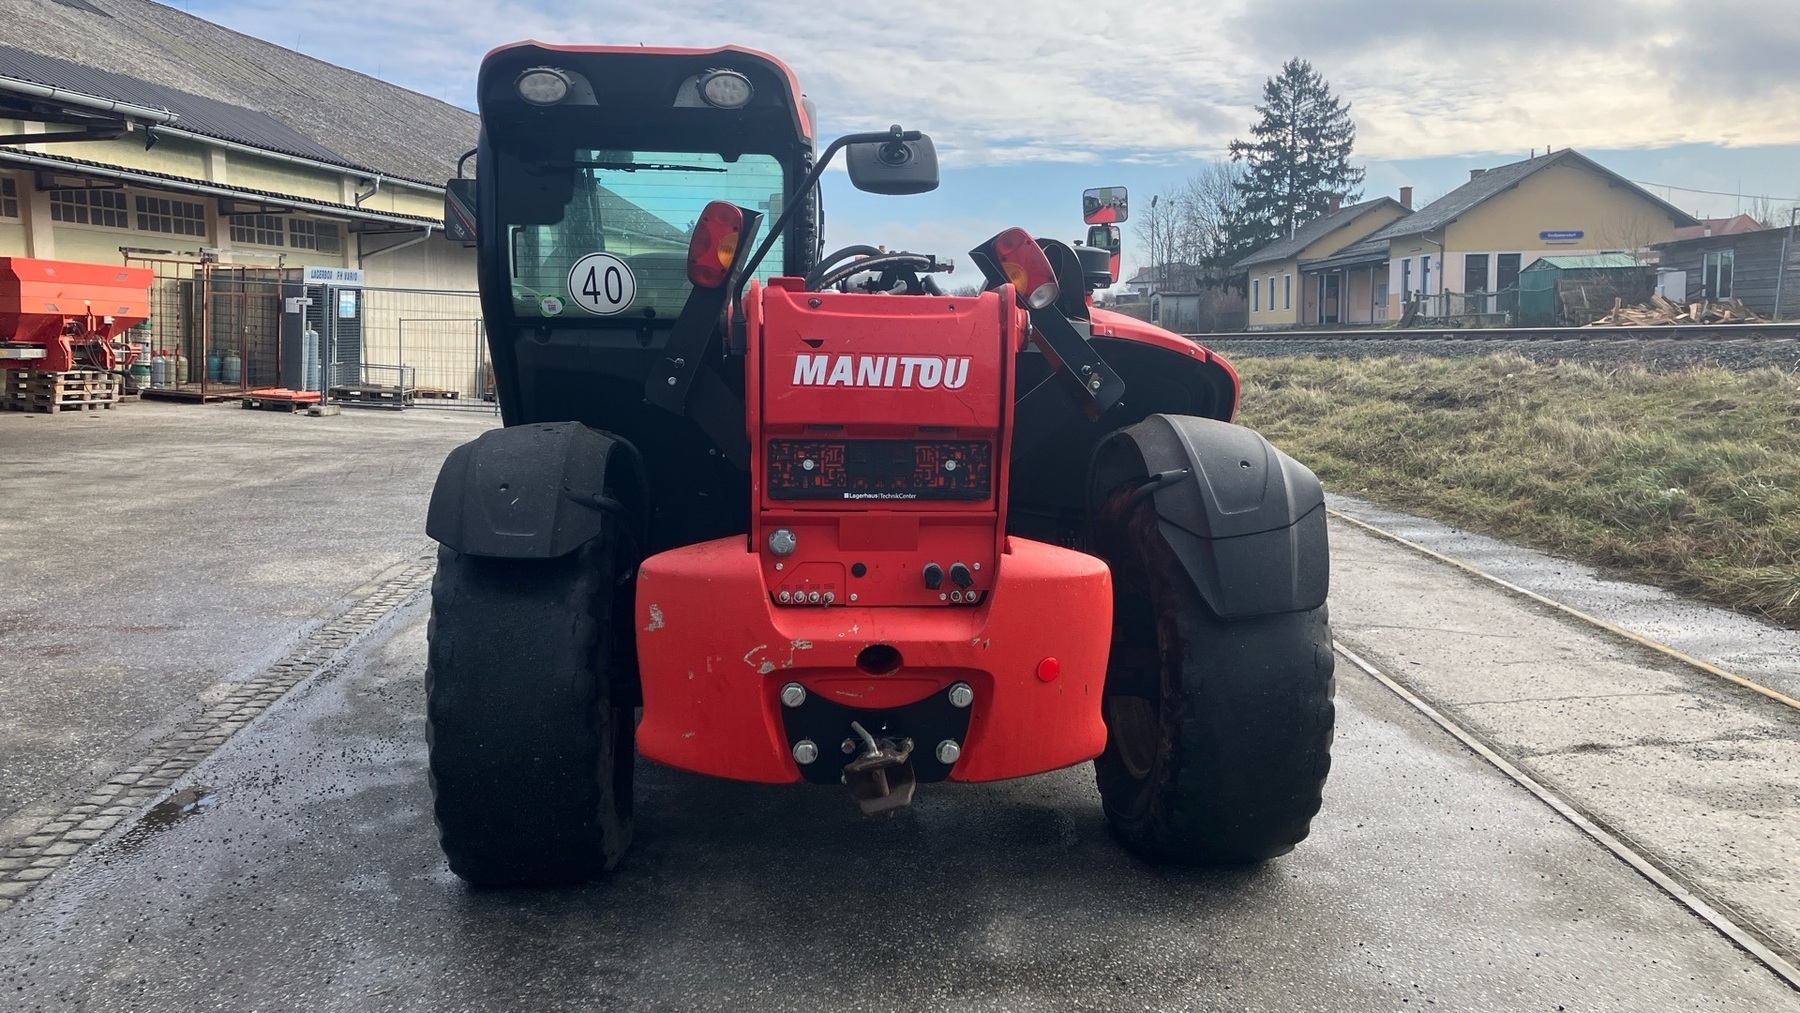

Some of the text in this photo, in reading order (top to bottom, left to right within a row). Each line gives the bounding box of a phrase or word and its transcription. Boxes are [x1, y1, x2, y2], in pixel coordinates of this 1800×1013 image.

[311, 269, 333, 280] LAGERBOX
[344, 271, 358, 281] VARIO
[582, 265, 622, 304] 40
[792, 354, 970, 389] MANITOU
